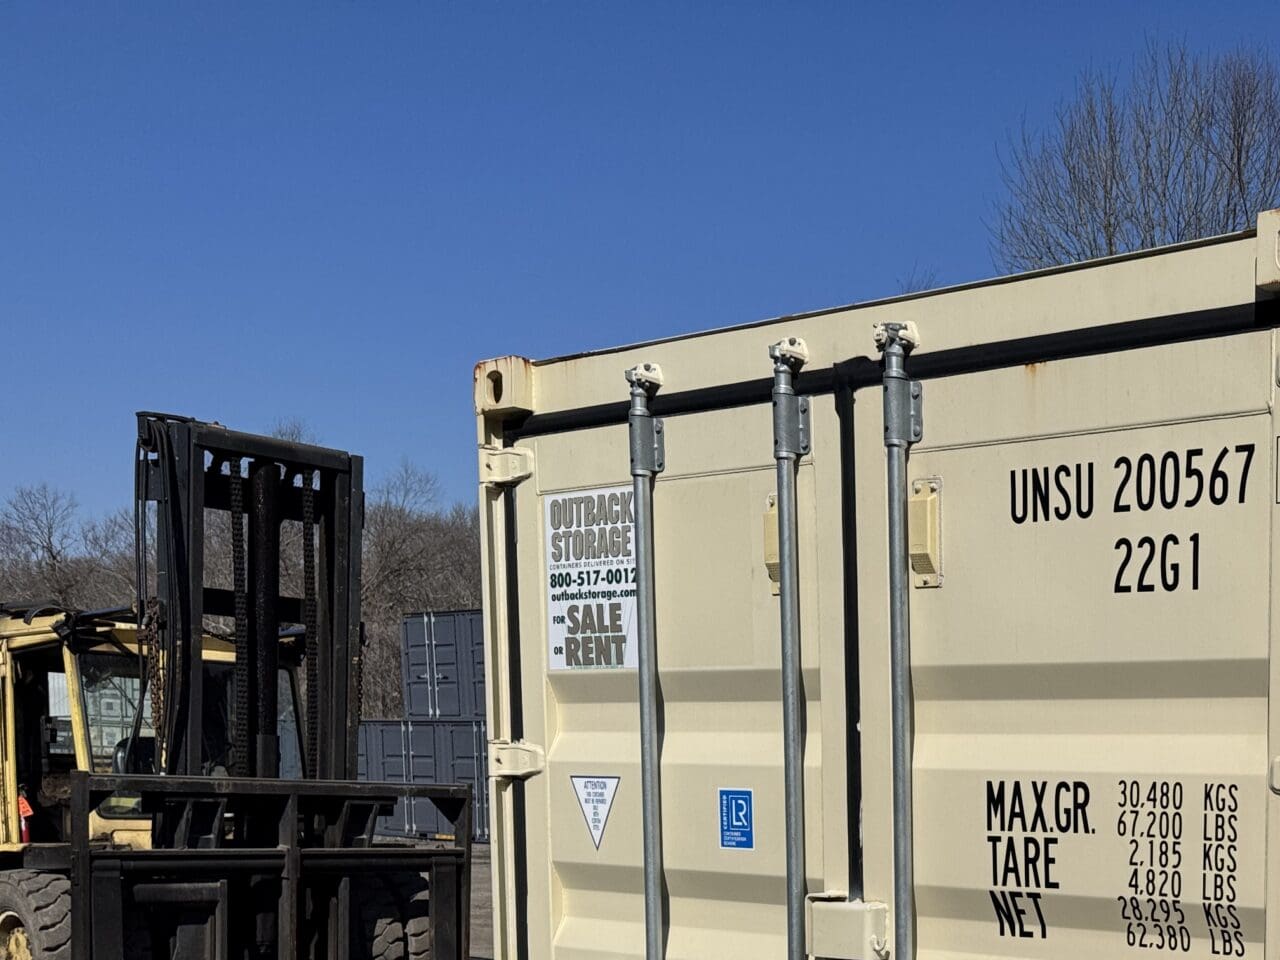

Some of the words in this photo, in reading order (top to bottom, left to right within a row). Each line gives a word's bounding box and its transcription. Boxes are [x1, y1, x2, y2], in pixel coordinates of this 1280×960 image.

[1010, 462, 1094, 524] UNSU
[1113, 443, 1255, 513] 200567
[550, 491, 634, 530] OUTBACK
[551, 525, 632, 562] STORAGE
[550, 567, 637, 588] 800-517-0012
[583, 560, 614, 568] DELIVERED
[626, 558, 637, 566] SIT
[1114, 532, 1200, 593] 22G1
[553, 616, 565, 624] FOR
[567, 603, 622, 636] SALE
[554, 646, 563, 655] OR
[565, 635, 626, 666] RENT
[732, 799, 748, 826] LR
[986, 780, 1096, 834] MAX.GR.
[1117, 779, 1183, 809] 30,480
[1203, 783, 1238, 812] KGS
[1117, 810, 1183, 838] 67,200
[1203, 813, 1238, 843] LBS
[987, 836, 1060, 889] TARE
[1129, 839, 1182, 868] 2,185
[1202, 844, 1238, 872] KGS
[1128, 868, 1182, 898] 4,820
[1202, 874, 1237, 903] LBS
[989, 890, 1047, 939] NET
[1203, 902, 1241, 929] KGS
[1126, 922, 1191, 952] 62,380
[1209, 928, 1245, 957] LBS
